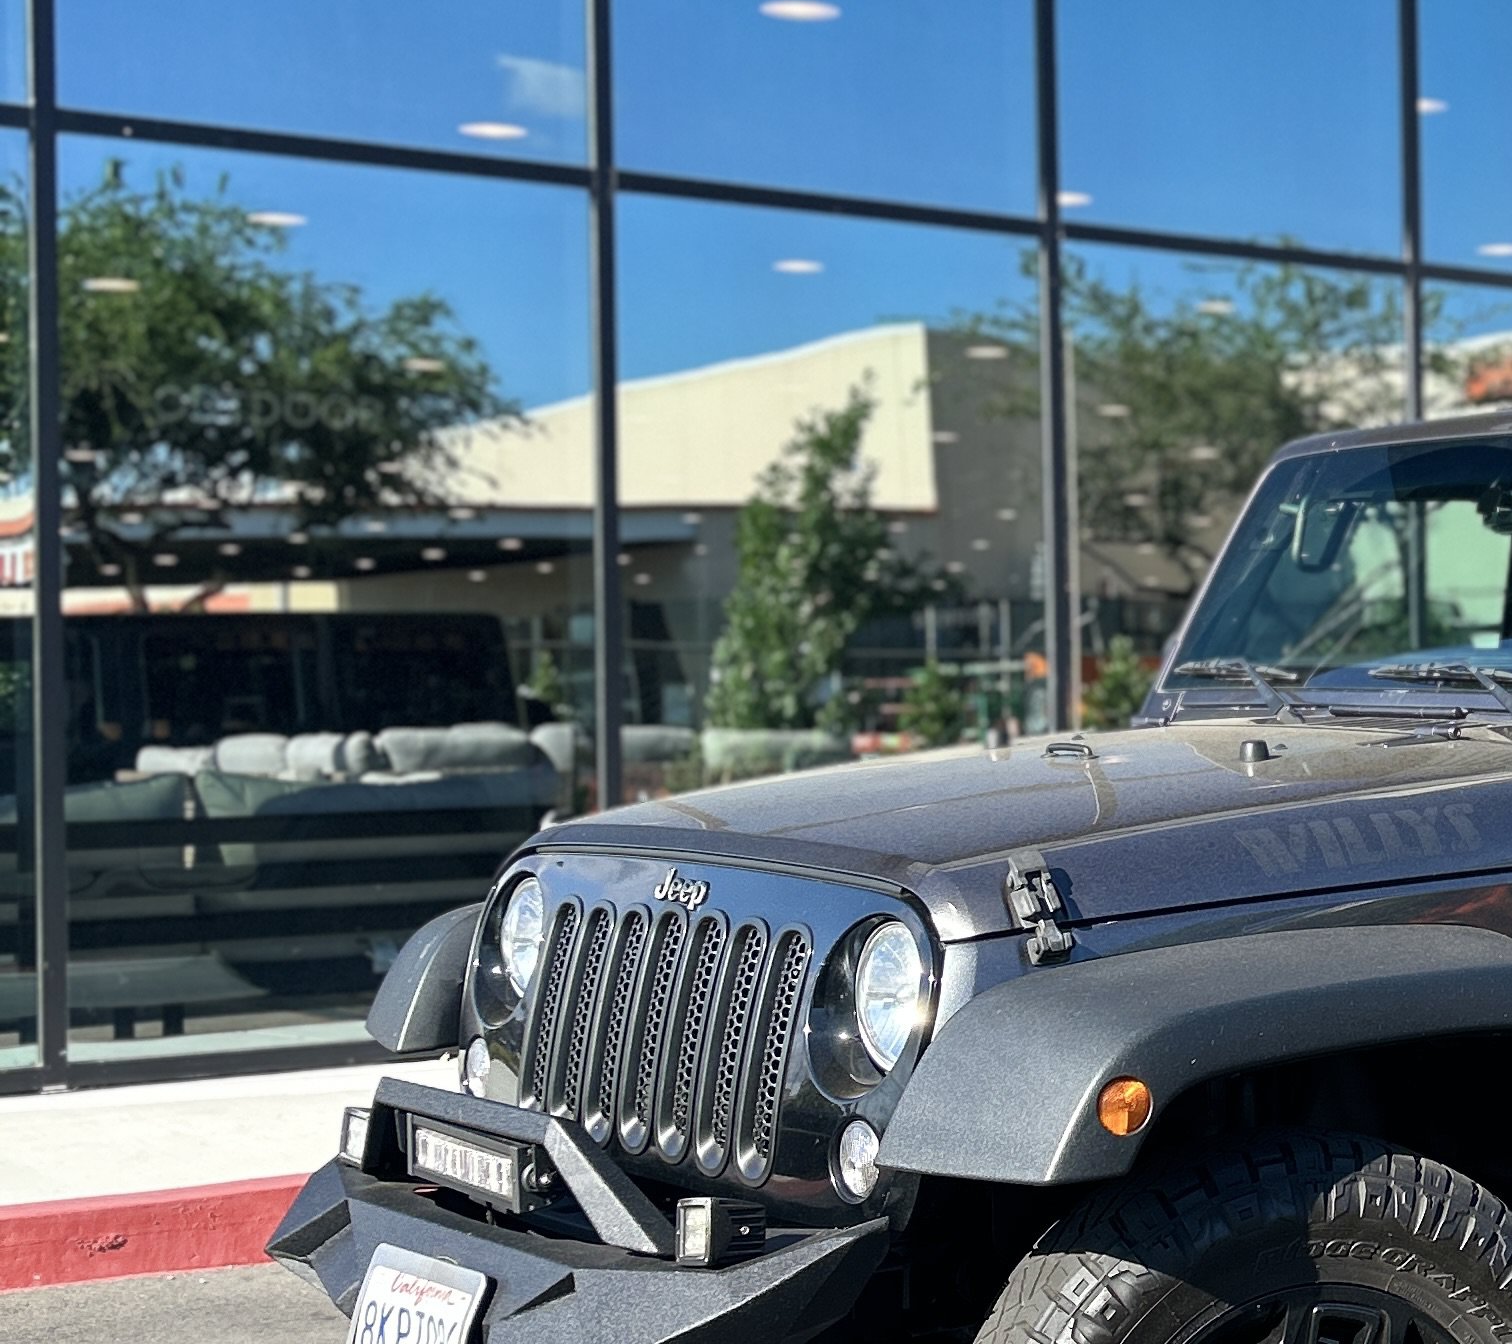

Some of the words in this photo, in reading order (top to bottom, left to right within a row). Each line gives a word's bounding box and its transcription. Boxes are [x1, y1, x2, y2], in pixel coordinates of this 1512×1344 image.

[1233, 803, 1481, 877] WILLYS
[654, 867, 710, 910] Jeep
[390, 1272, 455, 1306] California
